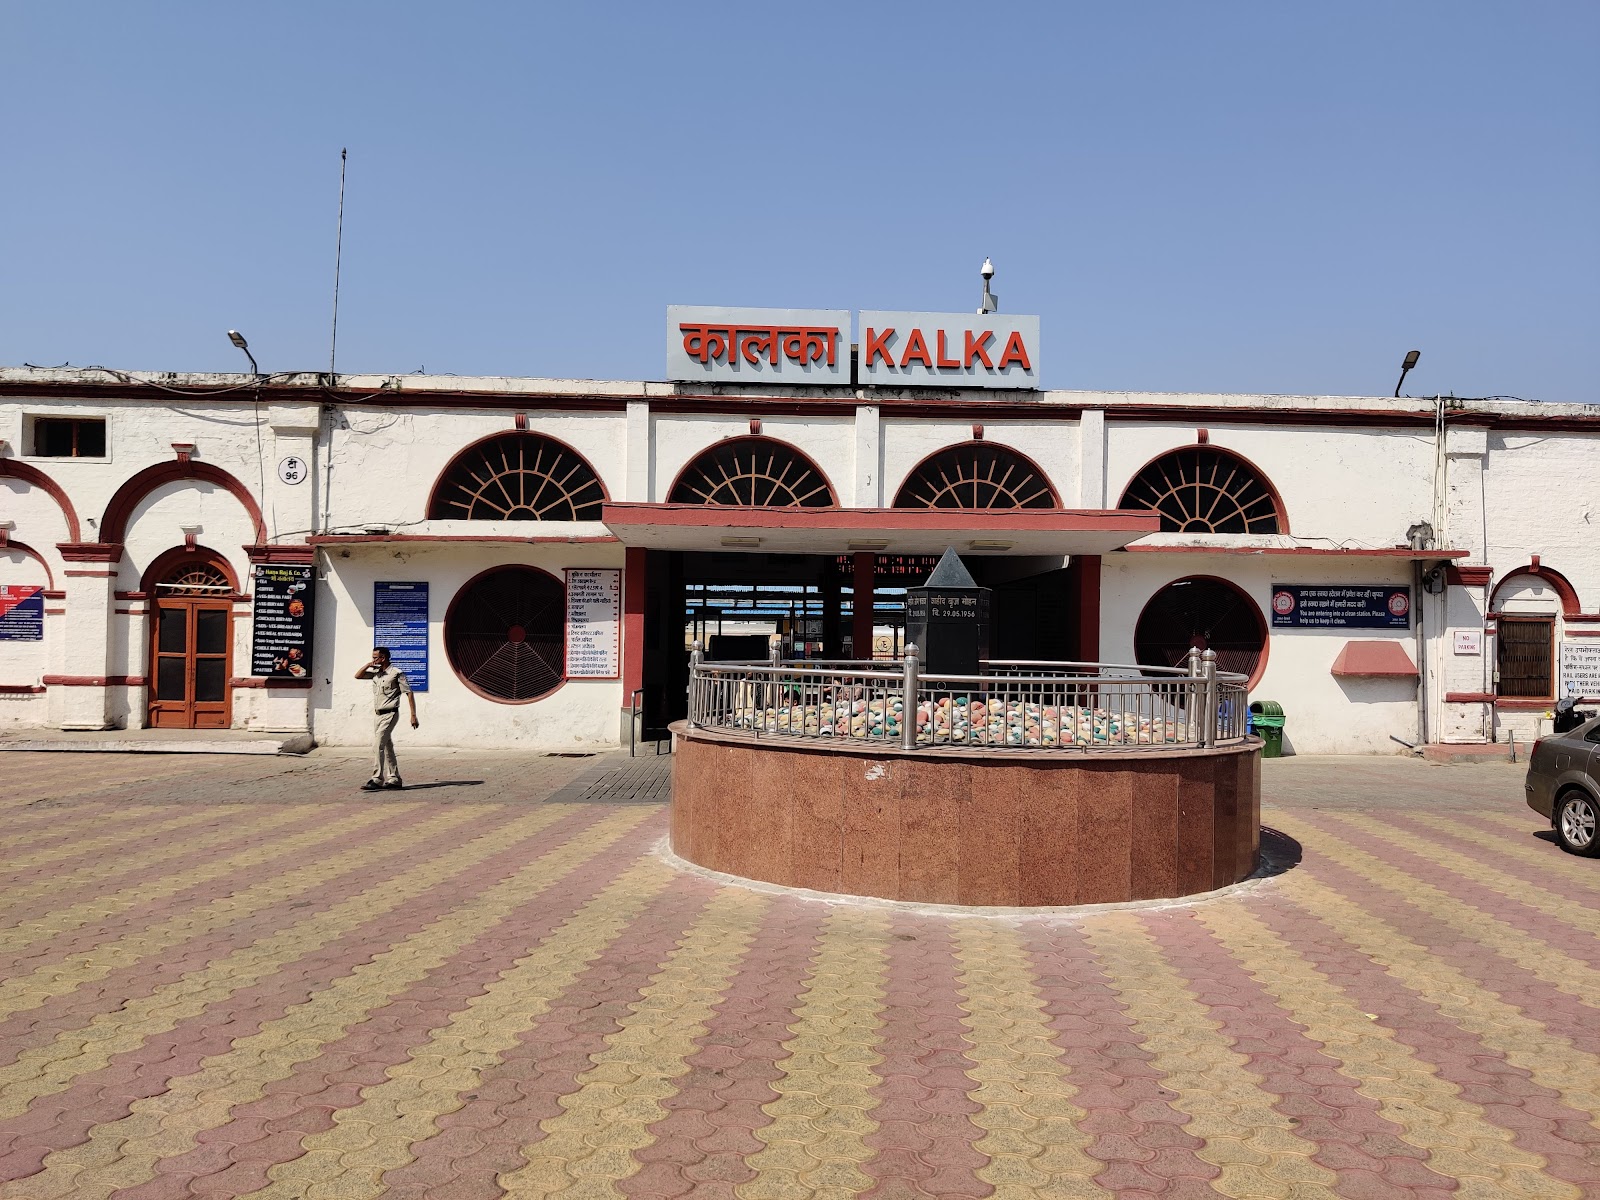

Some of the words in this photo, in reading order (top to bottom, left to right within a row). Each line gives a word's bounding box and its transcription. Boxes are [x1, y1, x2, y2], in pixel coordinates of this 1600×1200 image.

[679, 323, 839, 366] कालका
[865, 327, 1031, 370] KALKA
[285, 471, 298, 480] 96
[961, 595, 977, 606] मोहन
[942, 610, 976, 618] 29.05.1956
[1300, 617, 1308, 625] help
[1320, 617, 1329, 626] keep
